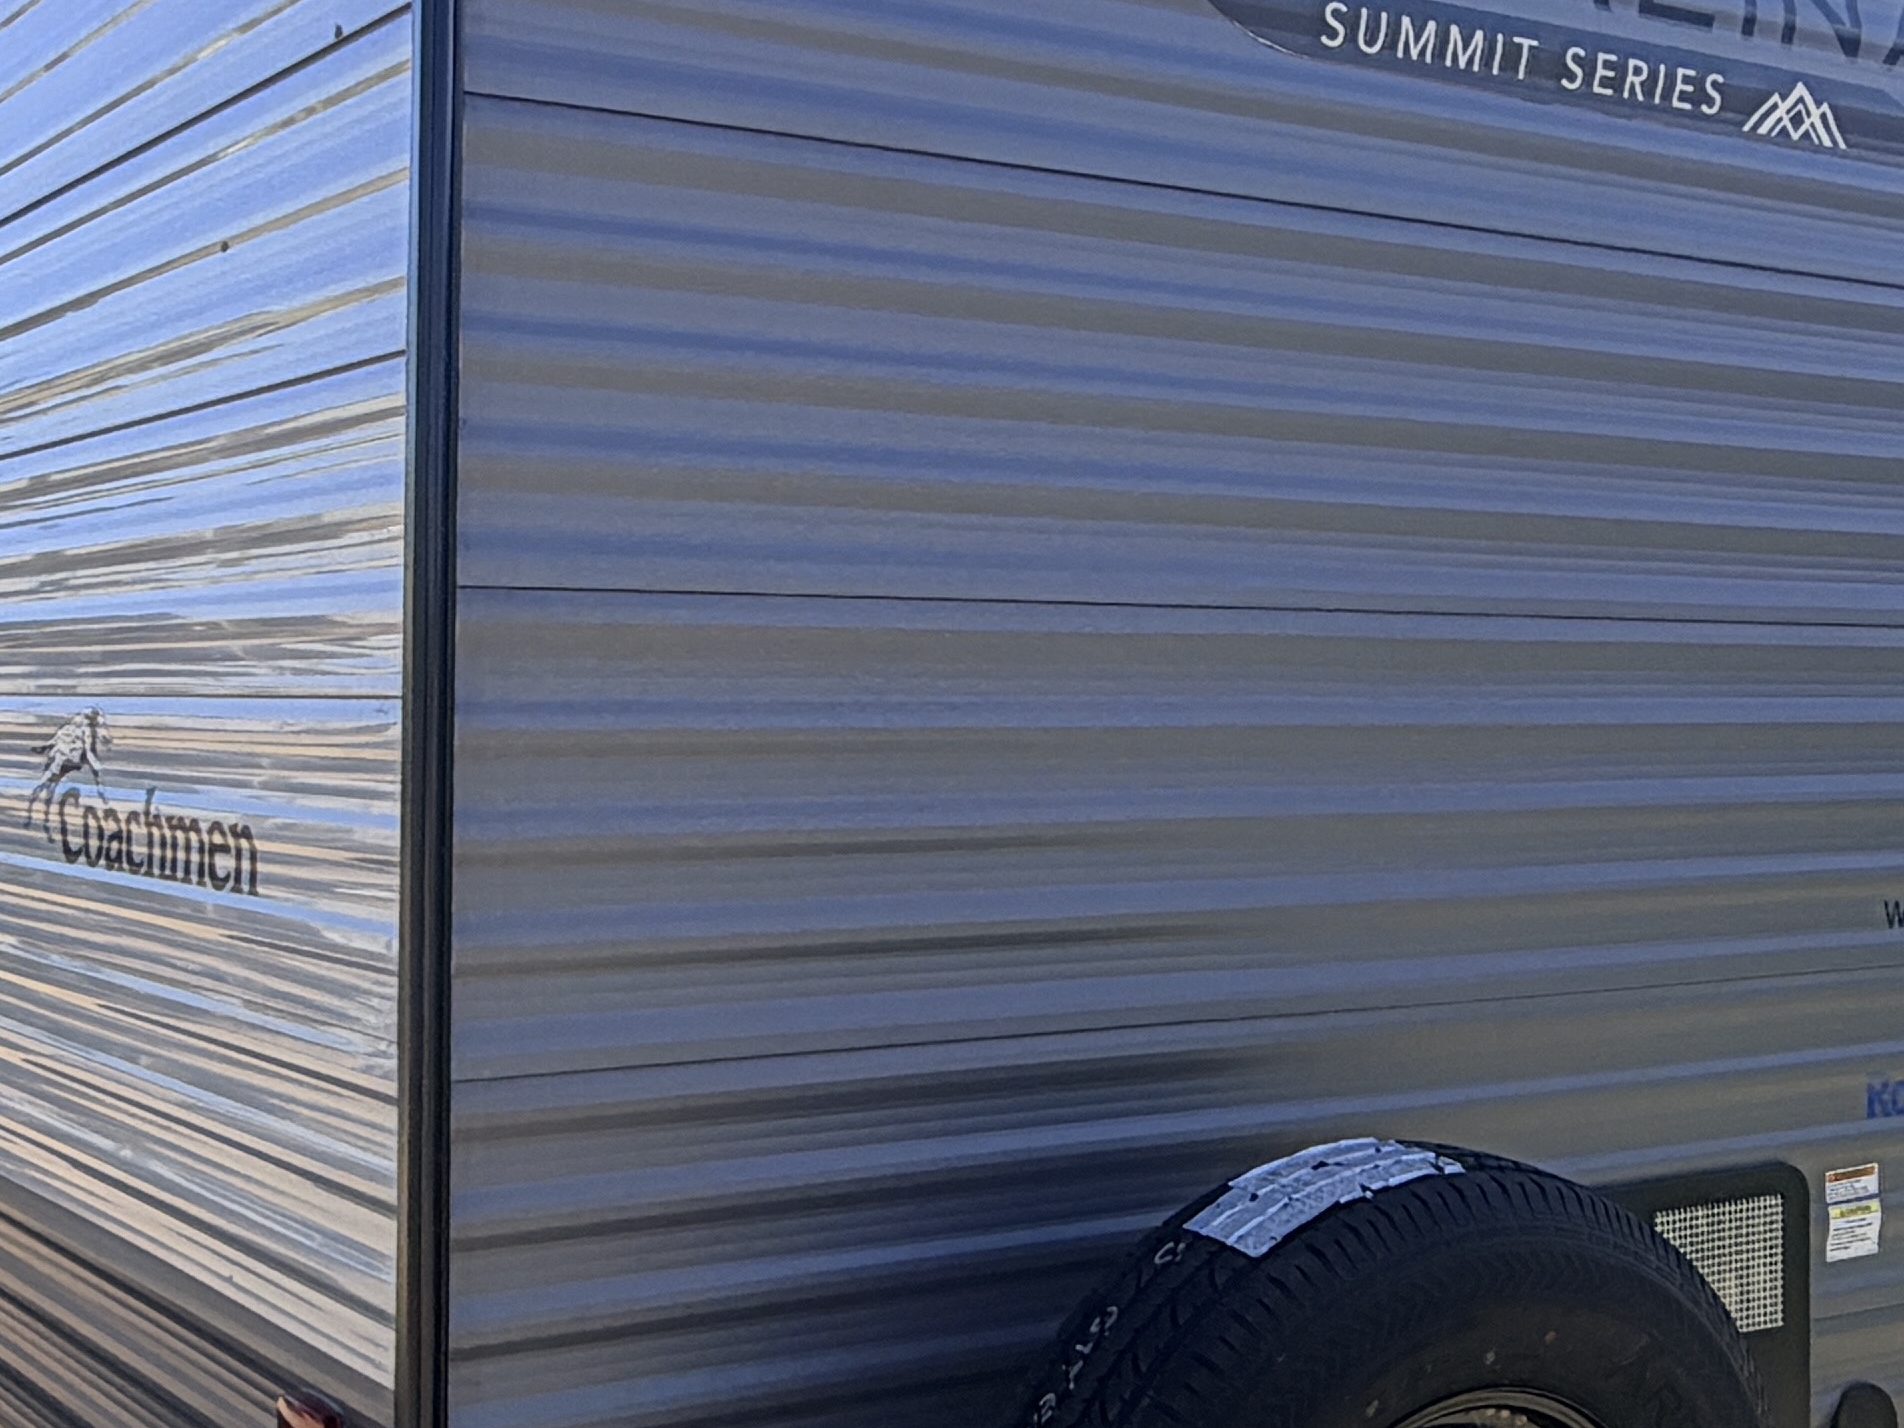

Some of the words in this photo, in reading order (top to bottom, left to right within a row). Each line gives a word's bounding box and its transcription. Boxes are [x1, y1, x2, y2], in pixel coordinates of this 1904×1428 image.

[1319, 1, 1539, 82] SUMMIT
[1560, 47, 1724, 115] SERIES
[58, 786, 260, 896] Coachmen
